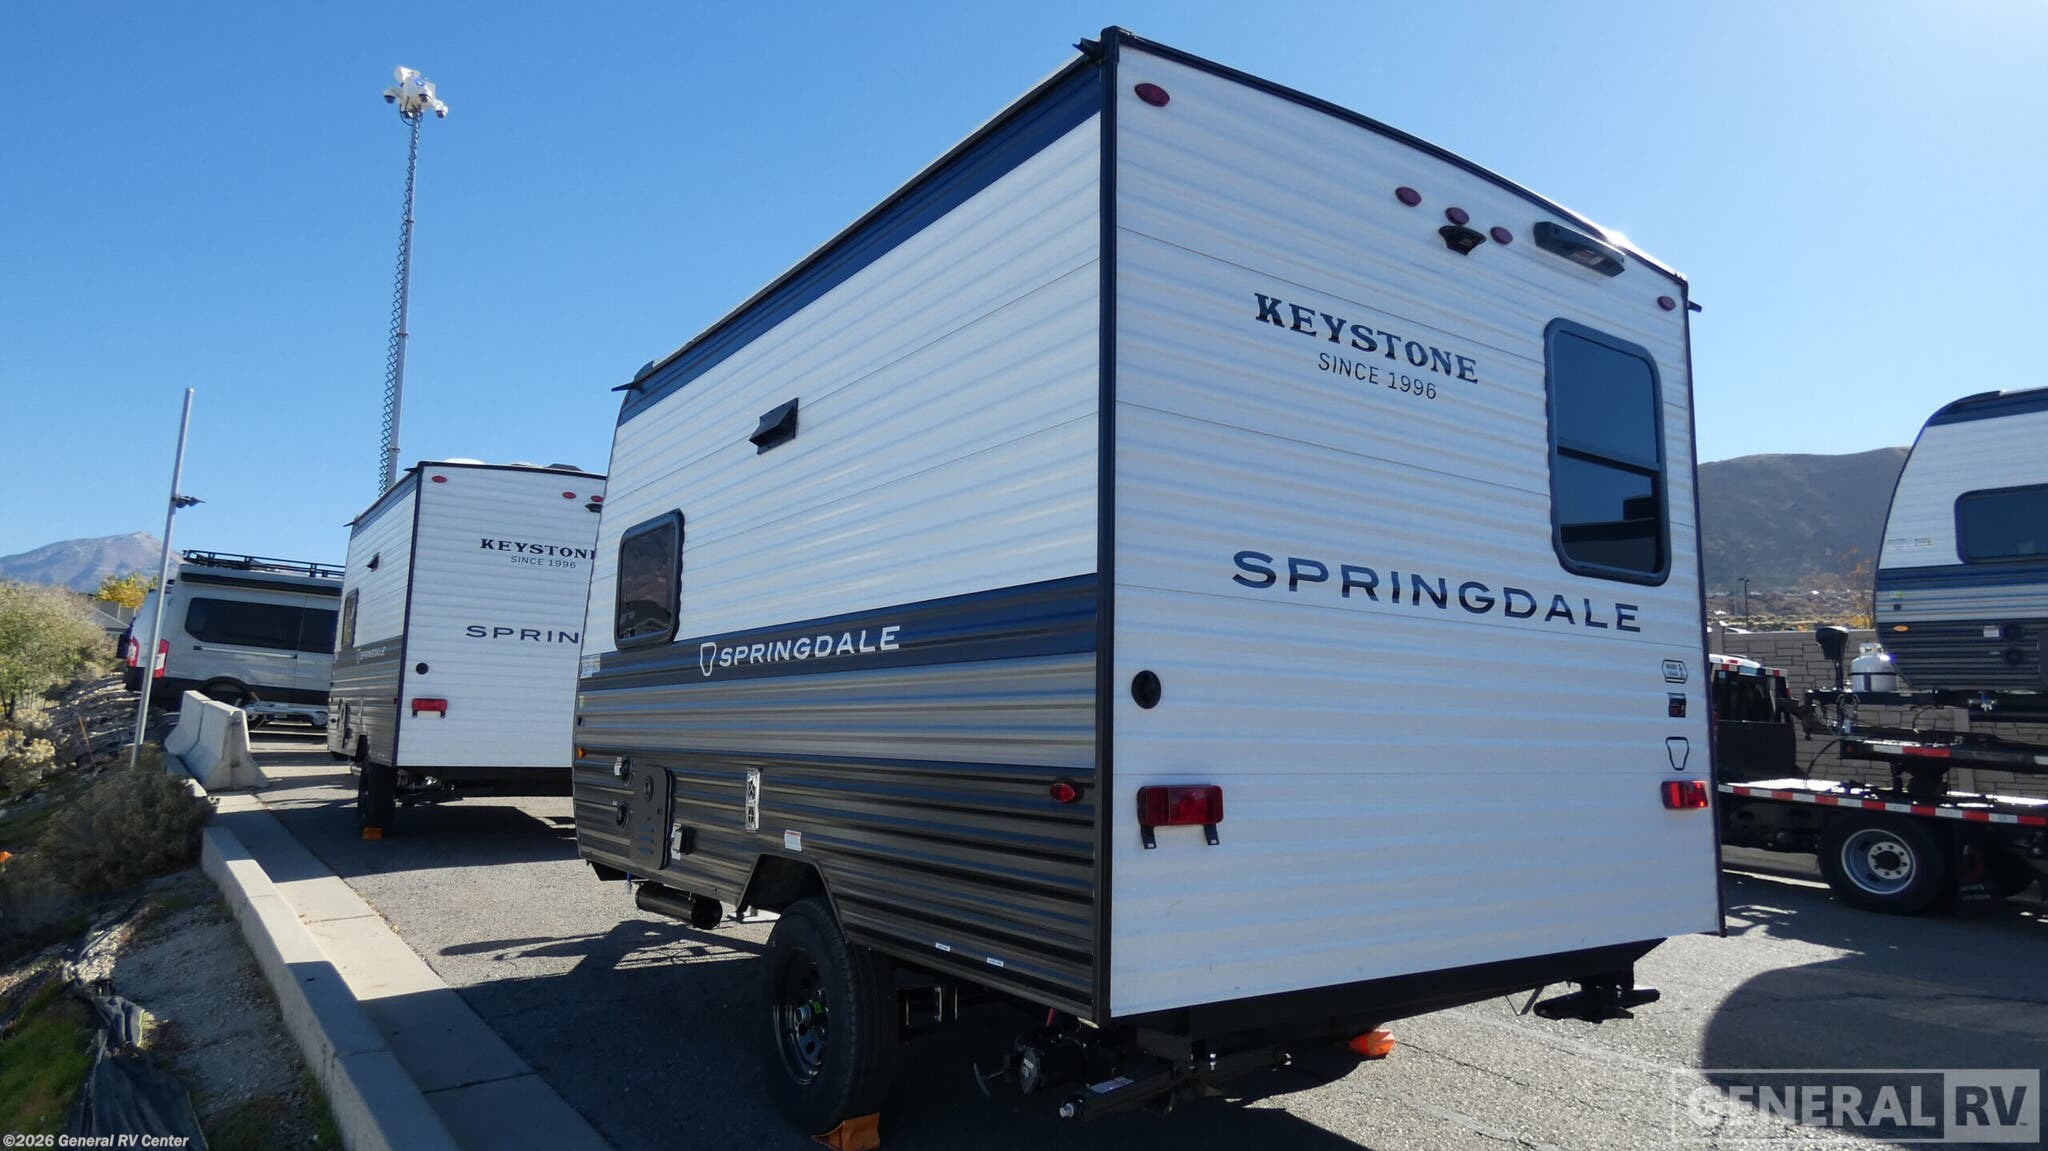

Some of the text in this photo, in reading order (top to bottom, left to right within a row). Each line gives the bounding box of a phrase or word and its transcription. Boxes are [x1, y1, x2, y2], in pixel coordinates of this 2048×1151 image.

[1254, 292, 1478, 384] KEYSTONE
[1318, 352, 1437, 400] SINCE 1996
[510, 555, 576, 569] SINCE 1996
[1232, 550, 1641, 633] SPRINGDALE
[719, 625, 900, 667] SPRINGDALE
